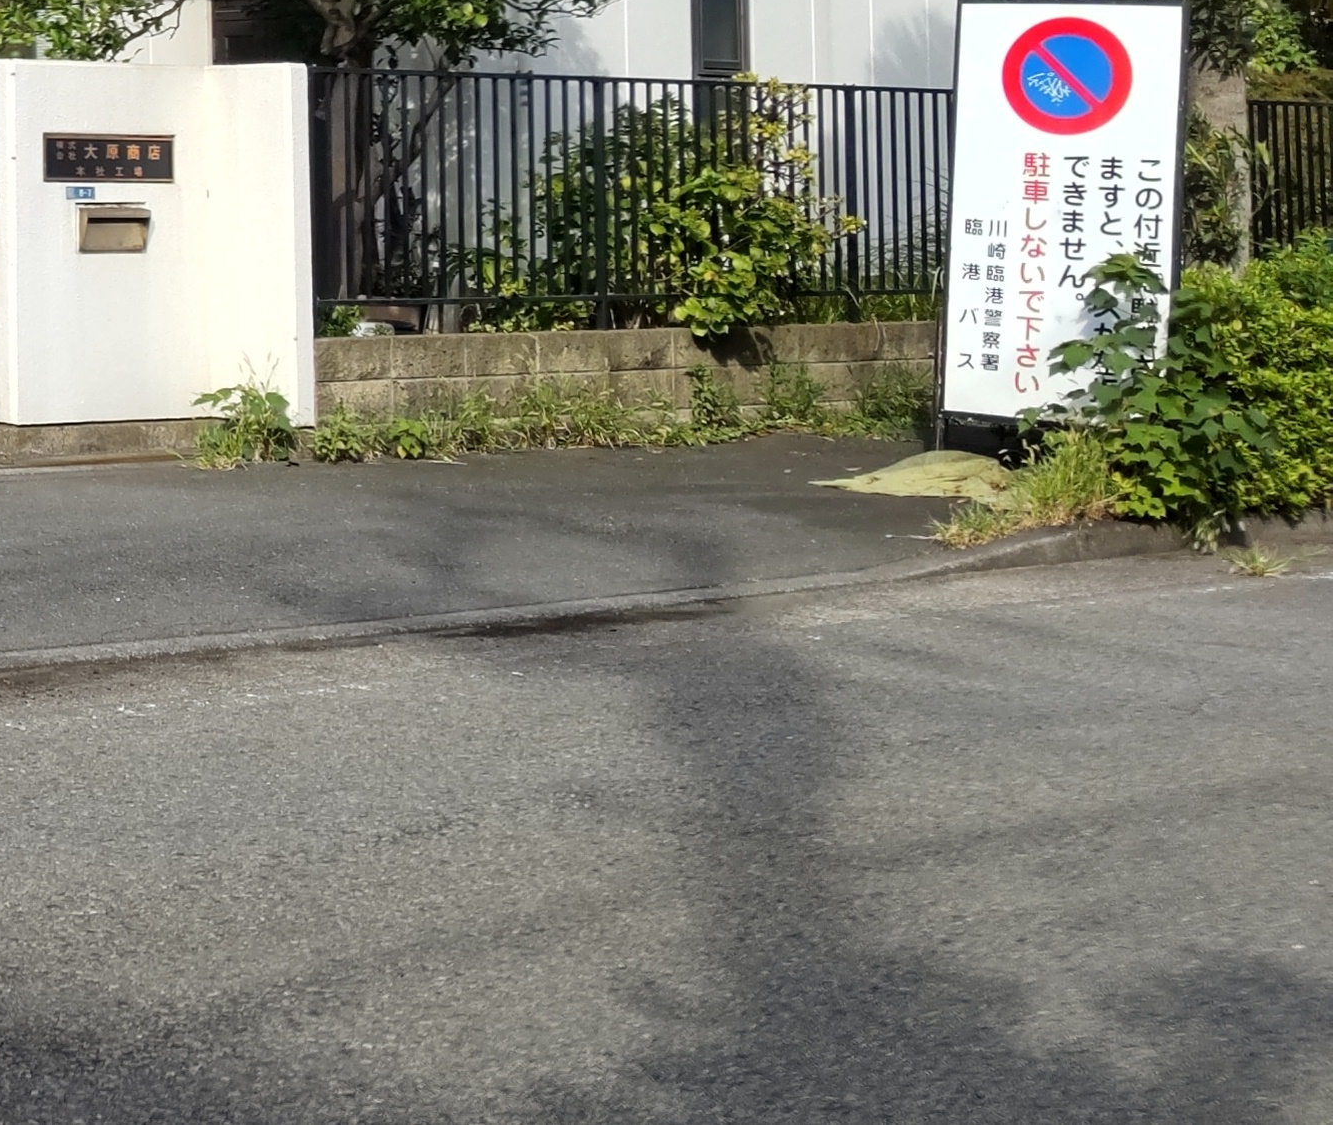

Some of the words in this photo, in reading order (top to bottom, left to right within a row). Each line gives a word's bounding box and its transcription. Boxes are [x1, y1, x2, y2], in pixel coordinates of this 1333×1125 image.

[83, 143, 161, 160] 大原商店
[957, 218, 983, 370] 臨港バス
[980, 219, 1008, 372] 川崎臨港警察署
[1014, 152, 1050, 393] 駐車しないで下さい
[1058, 156, 1089, 302] できません。
